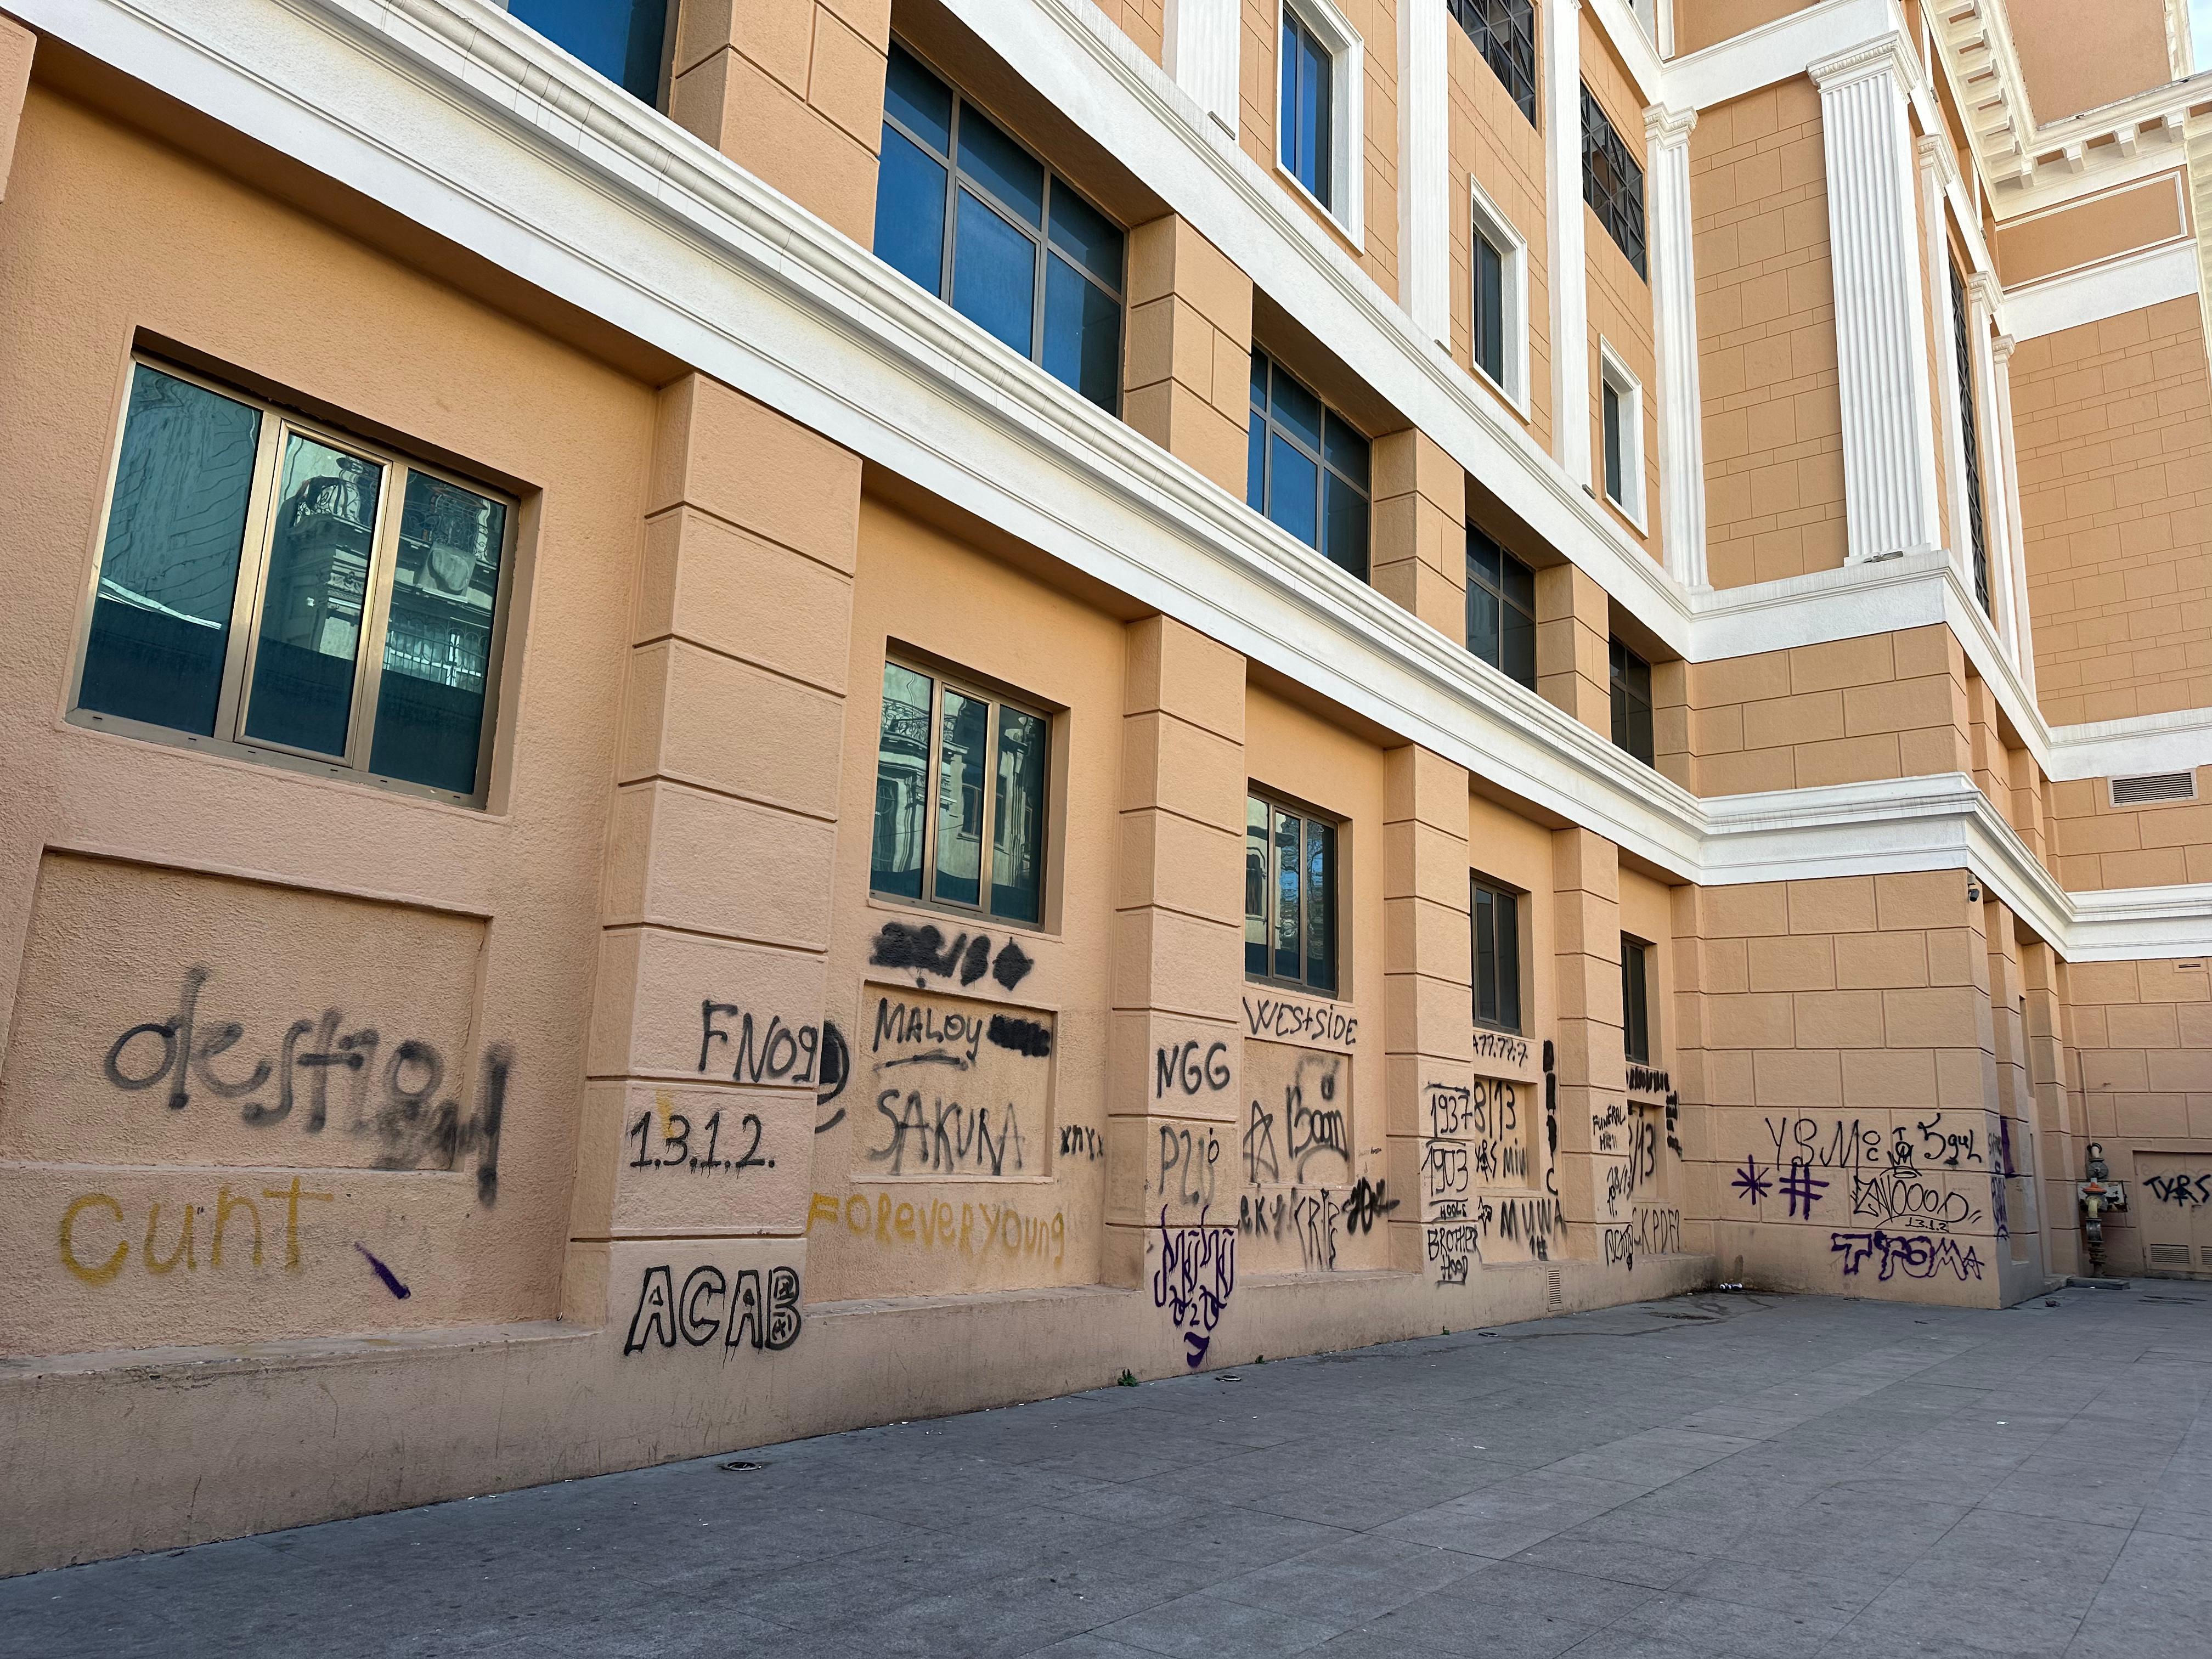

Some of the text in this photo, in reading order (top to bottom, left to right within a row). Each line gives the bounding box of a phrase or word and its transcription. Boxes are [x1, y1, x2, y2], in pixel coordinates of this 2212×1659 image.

[1156, 1040, 1231, 1099] NGG
[59, 1176, 334, 1287] cunt
[623, 1265, 802, 1356] ACAB
